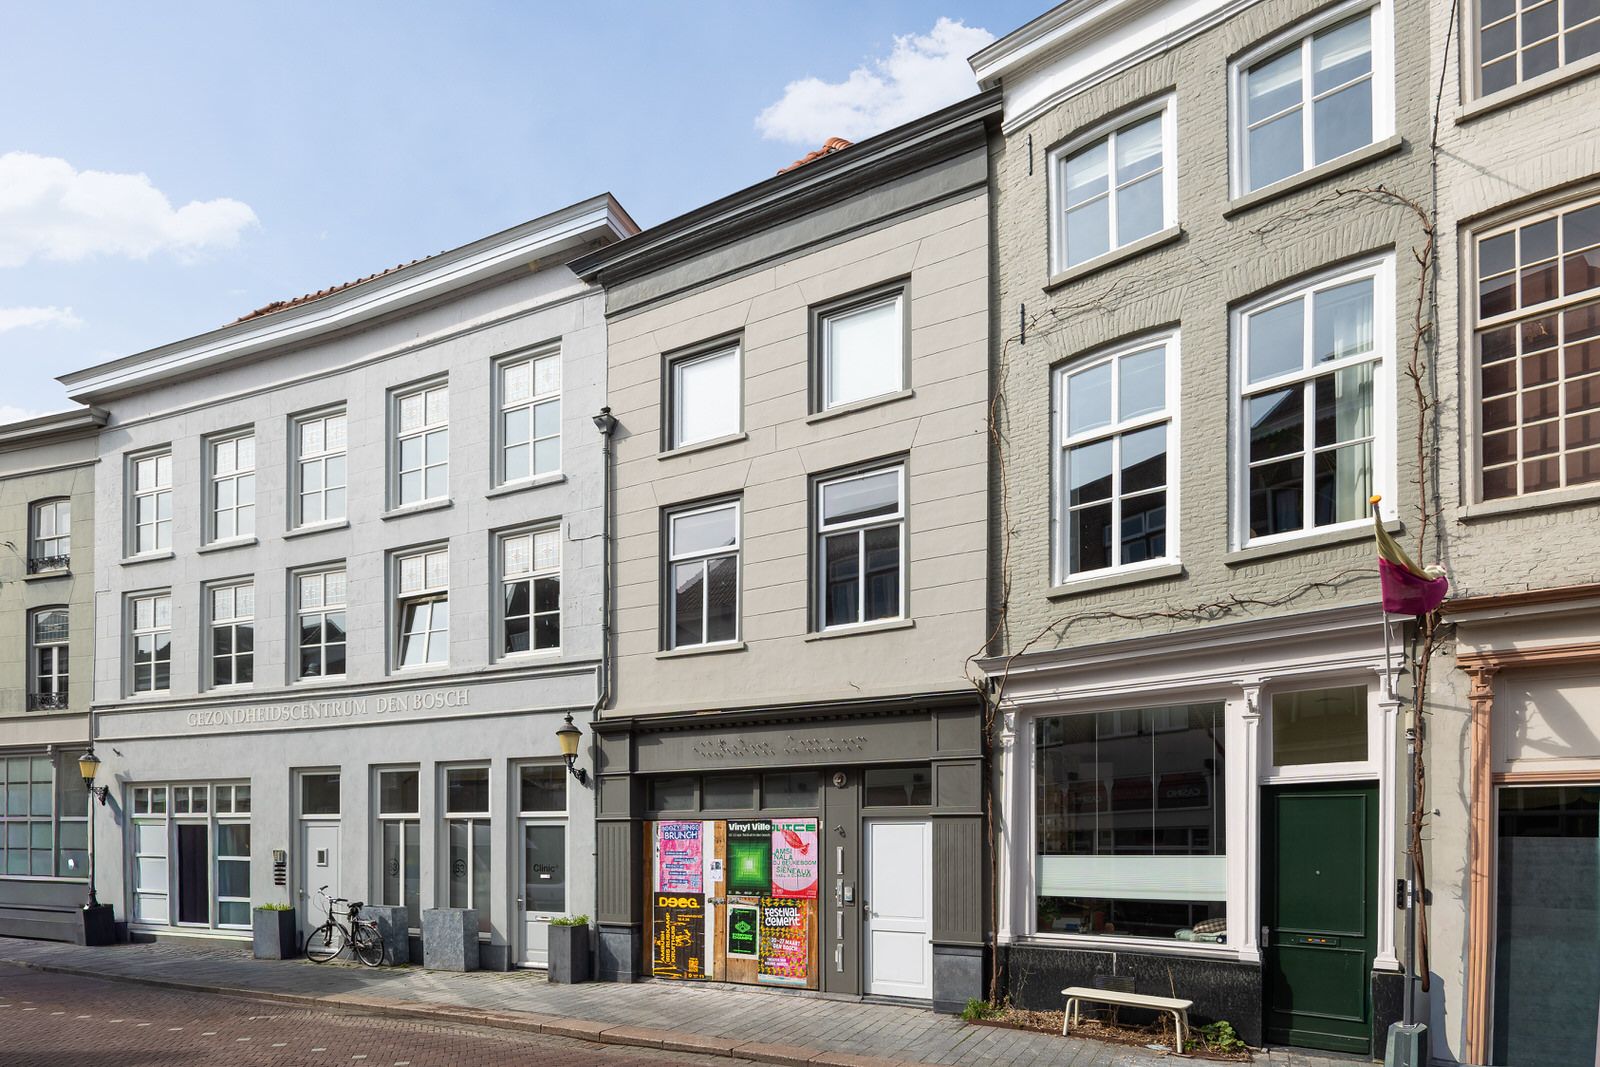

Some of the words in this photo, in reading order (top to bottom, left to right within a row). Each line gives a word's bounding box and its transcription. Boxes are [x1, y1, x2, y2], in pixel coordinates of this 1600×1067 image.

[187, 697, 368, 727] GEZONDHEIDSCENTRUM
[376, 695, 409, 714] DEN
[413, 689, 469, 711] BOSCH
[728, 822, 751, 832] Vinyl
[751, 822, 771, 831] Ville
[664, 831, 698, 840] BRUNCH
